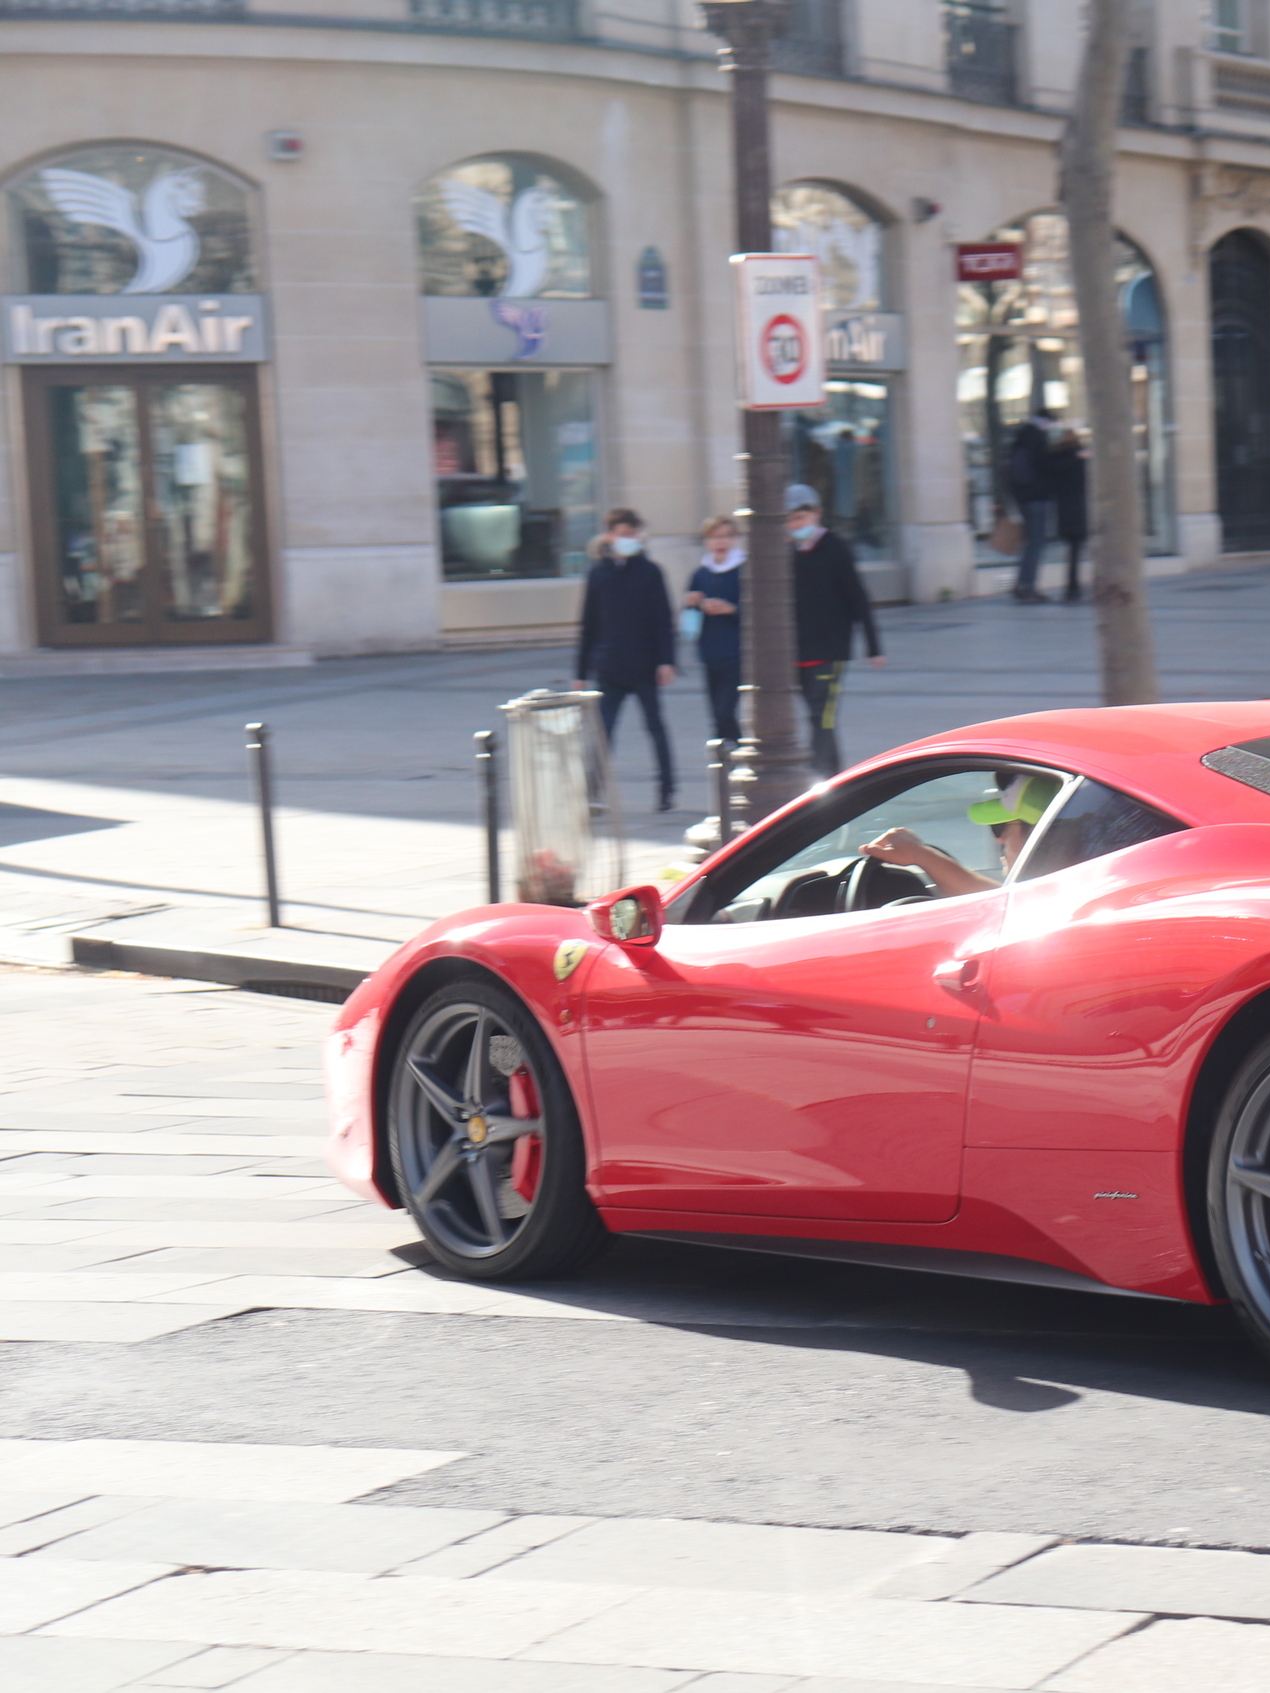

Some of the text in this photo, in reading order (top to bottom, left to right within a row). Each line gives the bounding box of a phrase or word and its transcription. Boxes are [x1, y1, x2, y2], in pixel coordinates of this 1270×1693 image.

[754, 275, 809, 296] ZONE
[10, 300, 254, 354] IranAir
[825, 314, 886, 362] nAir
